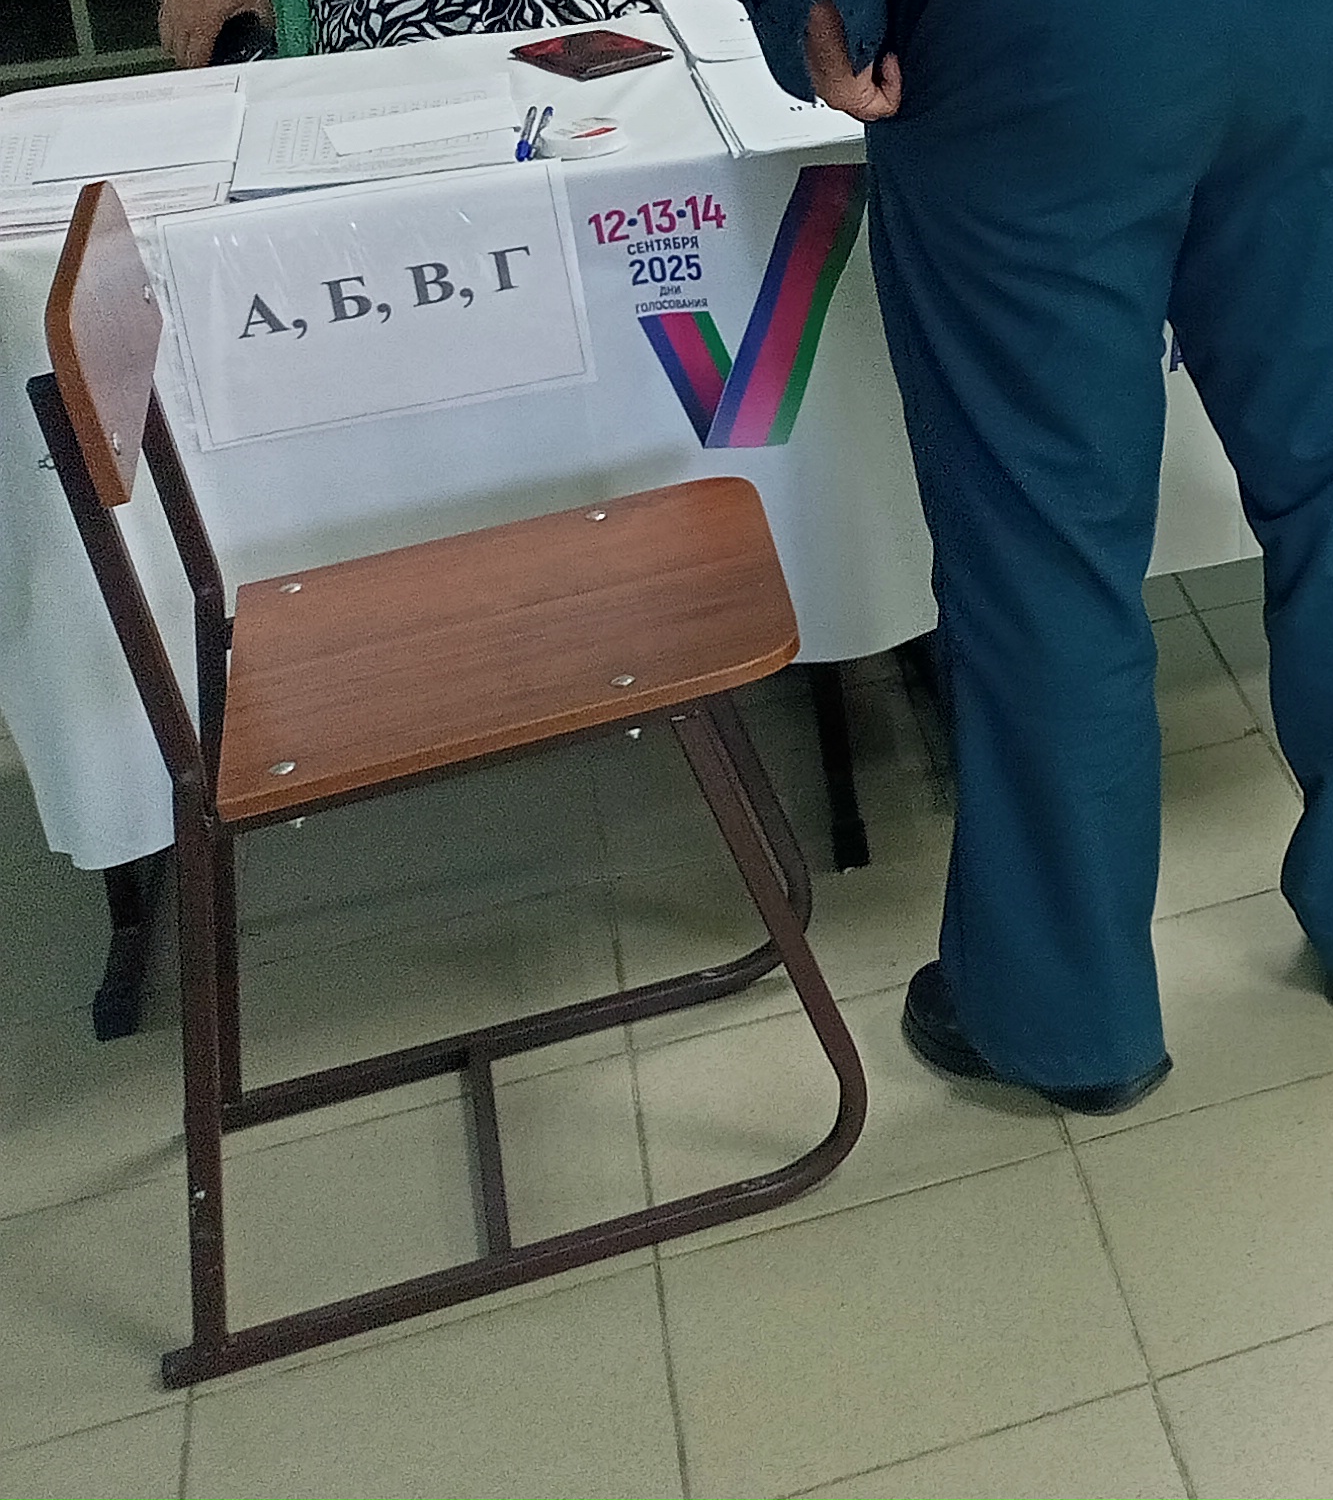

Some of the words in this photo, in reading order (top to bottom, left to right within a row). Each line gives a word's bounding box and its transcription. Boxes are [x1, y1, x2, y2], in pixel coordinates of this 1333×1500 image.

[627, 236, 700, 256] СЕНТЯБРЯ
[628, 253, 703, 287] 2025
[237, 292, 308, 340] А,
[320, 275, 392, 324] Б,
[404, 262, 475, 308] В,
[488, 245, 531, 293] Г
[659, 285, 682, 297] ДНИ
[635, 298, 708, 315] ГОЛОСОВАНИЯ
